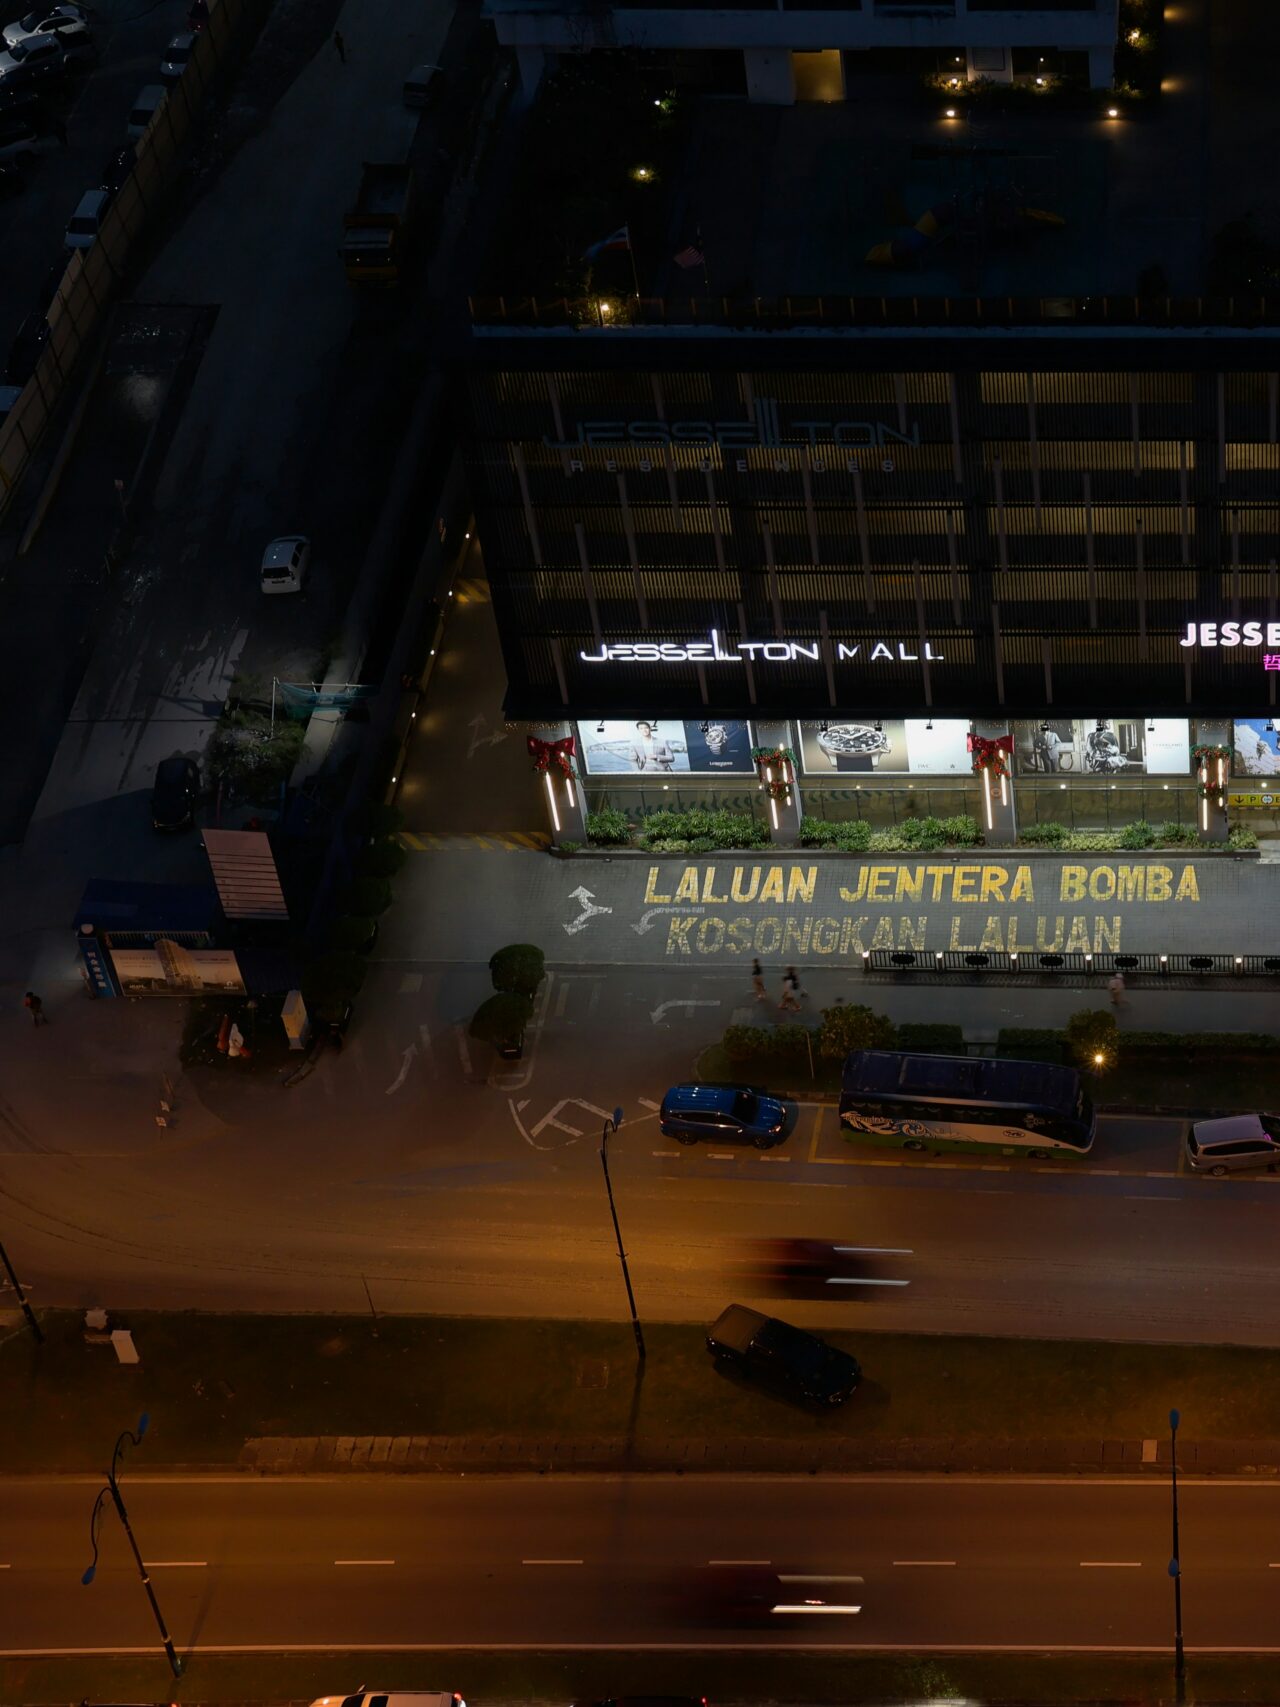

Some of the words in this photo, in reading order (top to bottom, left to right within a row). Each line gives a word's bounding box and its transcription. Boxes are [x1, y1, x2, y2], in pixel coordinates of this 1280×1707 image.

[542, 398, 920, 449] JESSELTON
[580, 629, 819, 661] JESSELTON
[839, 642, 944, 660] MALL
[644, 866, 818, 904] LALUAN
[839, 865, 1034, 903] JENTERA
[1060, 864, 1200, 902] BOMBA
[665, 915, 926, 956] KOSONGKAN
[949, 915, 1122, 954] LALUAN
